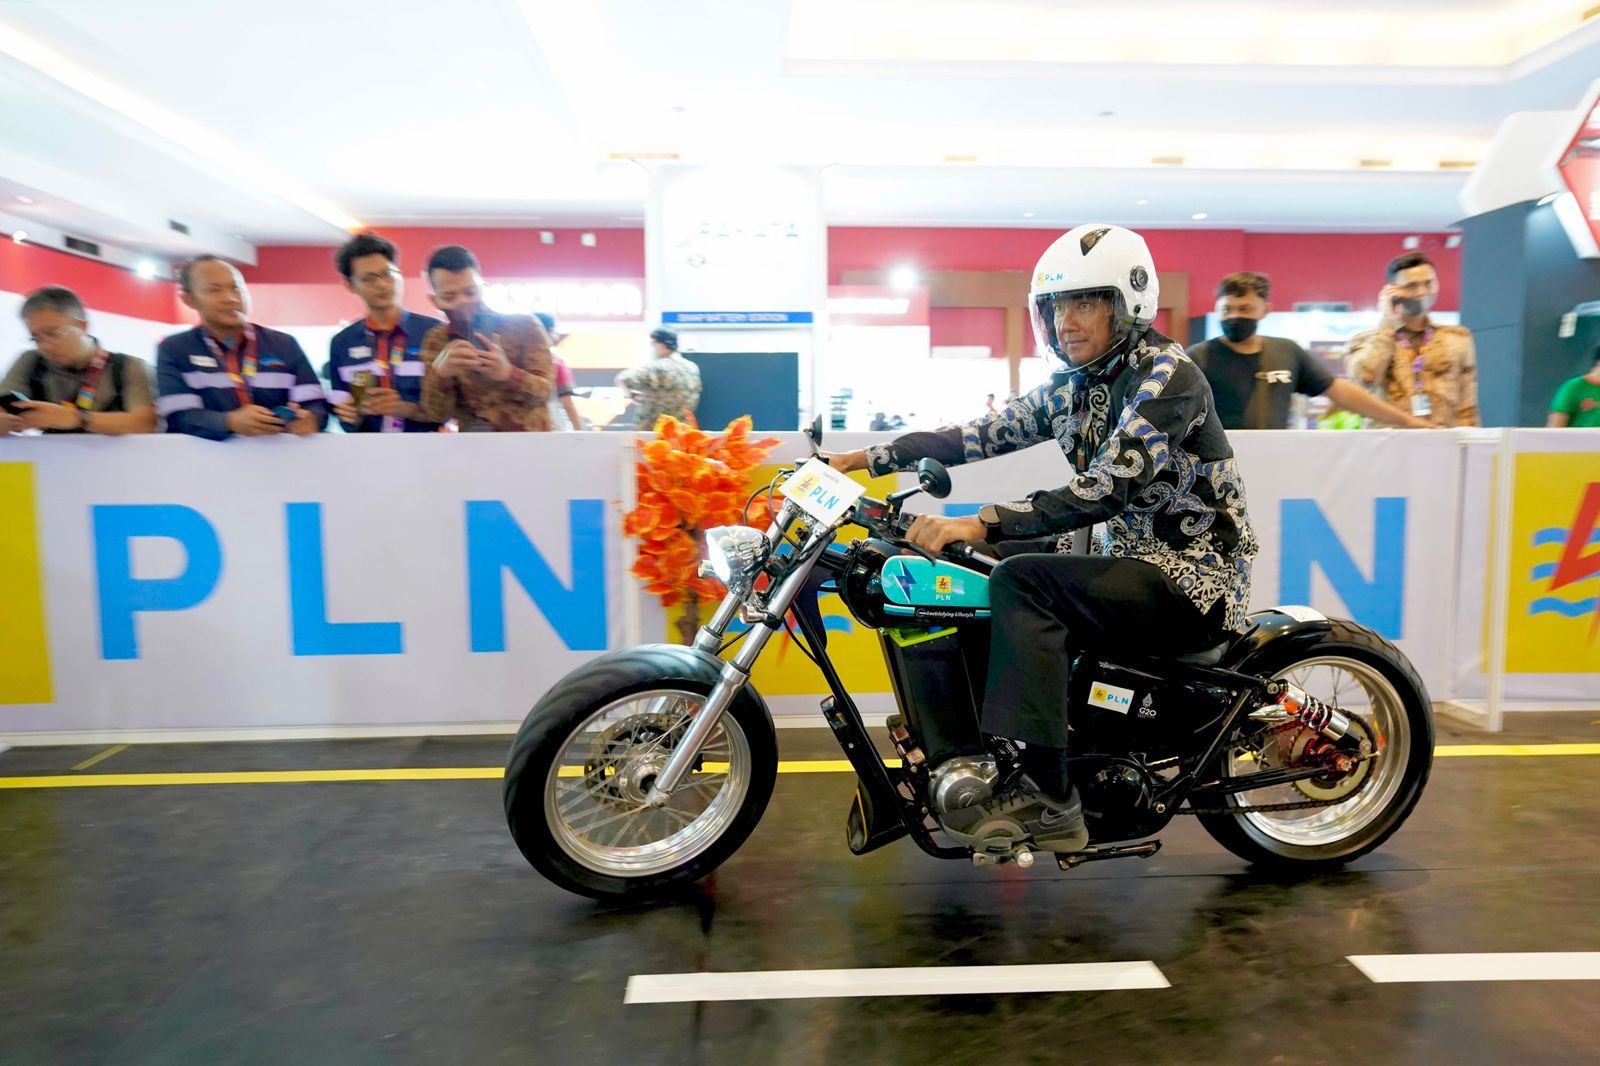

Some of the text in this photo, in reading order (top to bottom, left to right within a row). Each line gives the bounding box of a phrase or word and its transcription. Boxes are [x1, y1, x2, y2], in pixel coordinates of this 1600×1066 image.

[1045, 273, 1063, 281] PLN
[809, 485, 840, 510] PLN
[91, 499, 608, 660] PLN
[1107, 694, 1129, 705] PLN
